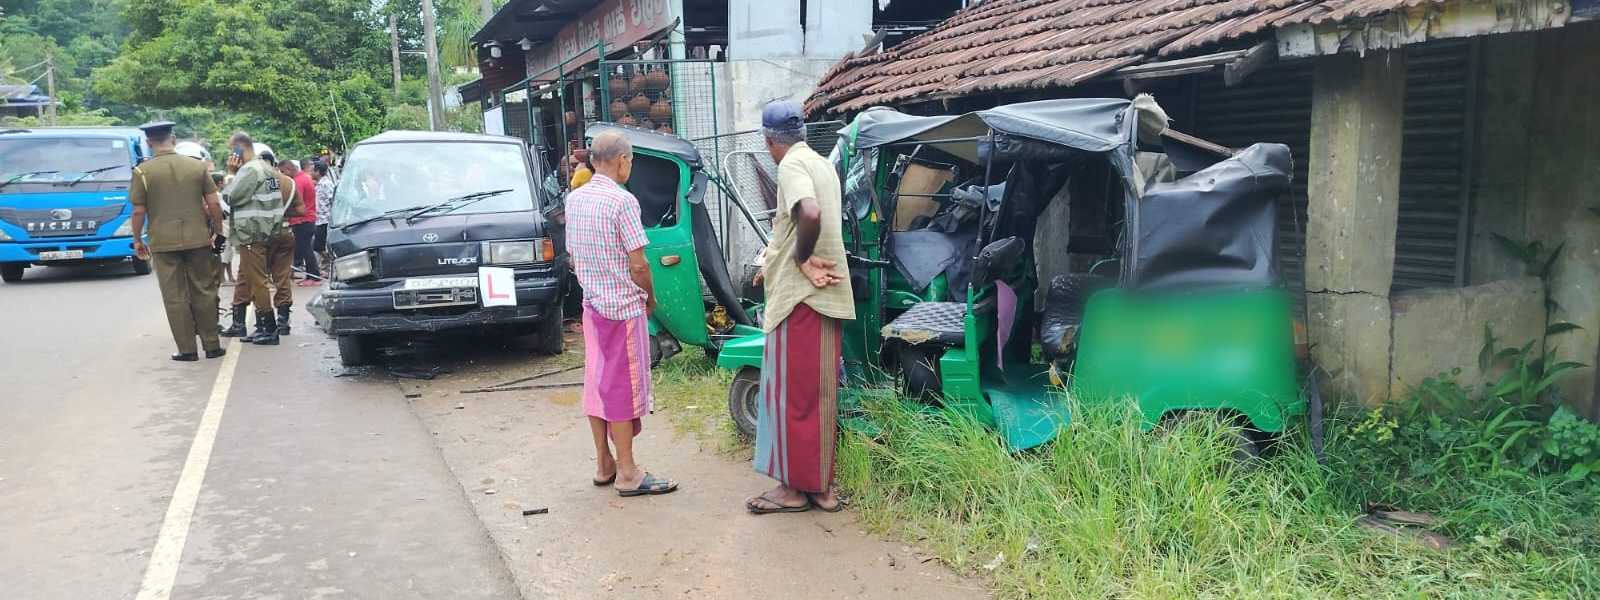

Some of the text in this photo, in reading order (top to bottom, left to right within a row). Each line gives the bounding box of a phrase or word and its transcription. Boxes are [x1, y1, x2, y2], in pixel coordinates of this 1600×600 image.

[27, 220, 97, 231] EICHER
[437, 256, 478, 265] LITEACE
[486, 272, 510, 299] L
